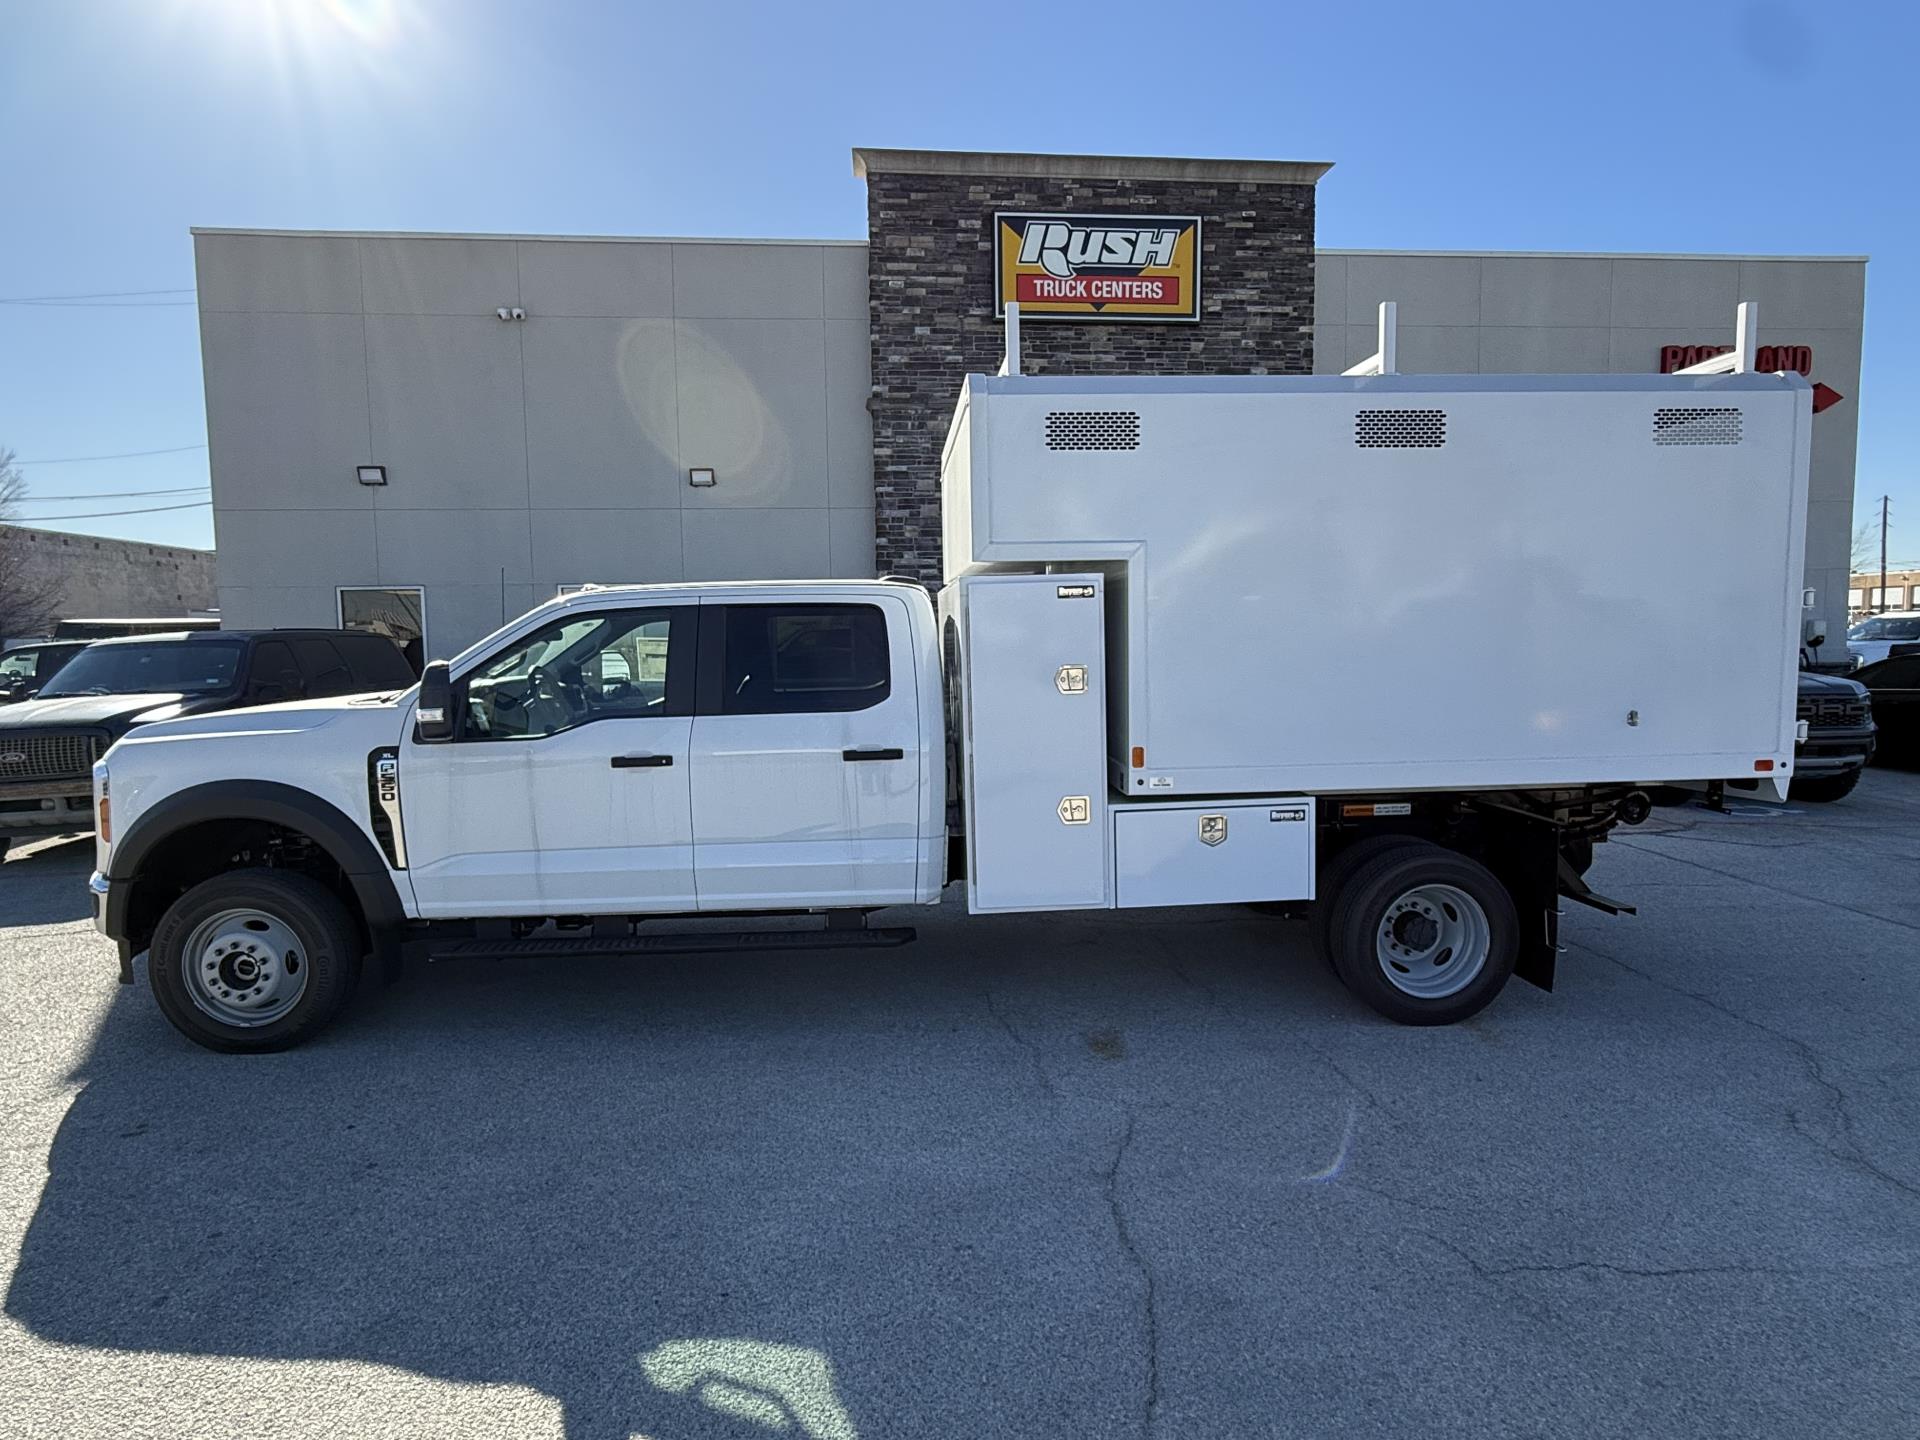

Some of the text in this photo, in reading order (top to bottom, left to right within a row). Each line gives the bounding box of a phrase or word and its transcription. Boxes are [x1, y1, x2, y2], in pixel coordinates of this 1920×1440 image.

[1017, 221, 1179, 278] RUSH
[1033, 279, 1163, 299] TRUCK CENTERS
[1755, 345, 1812, 376] AND
[1797, 703, 1867, 716] ORD
